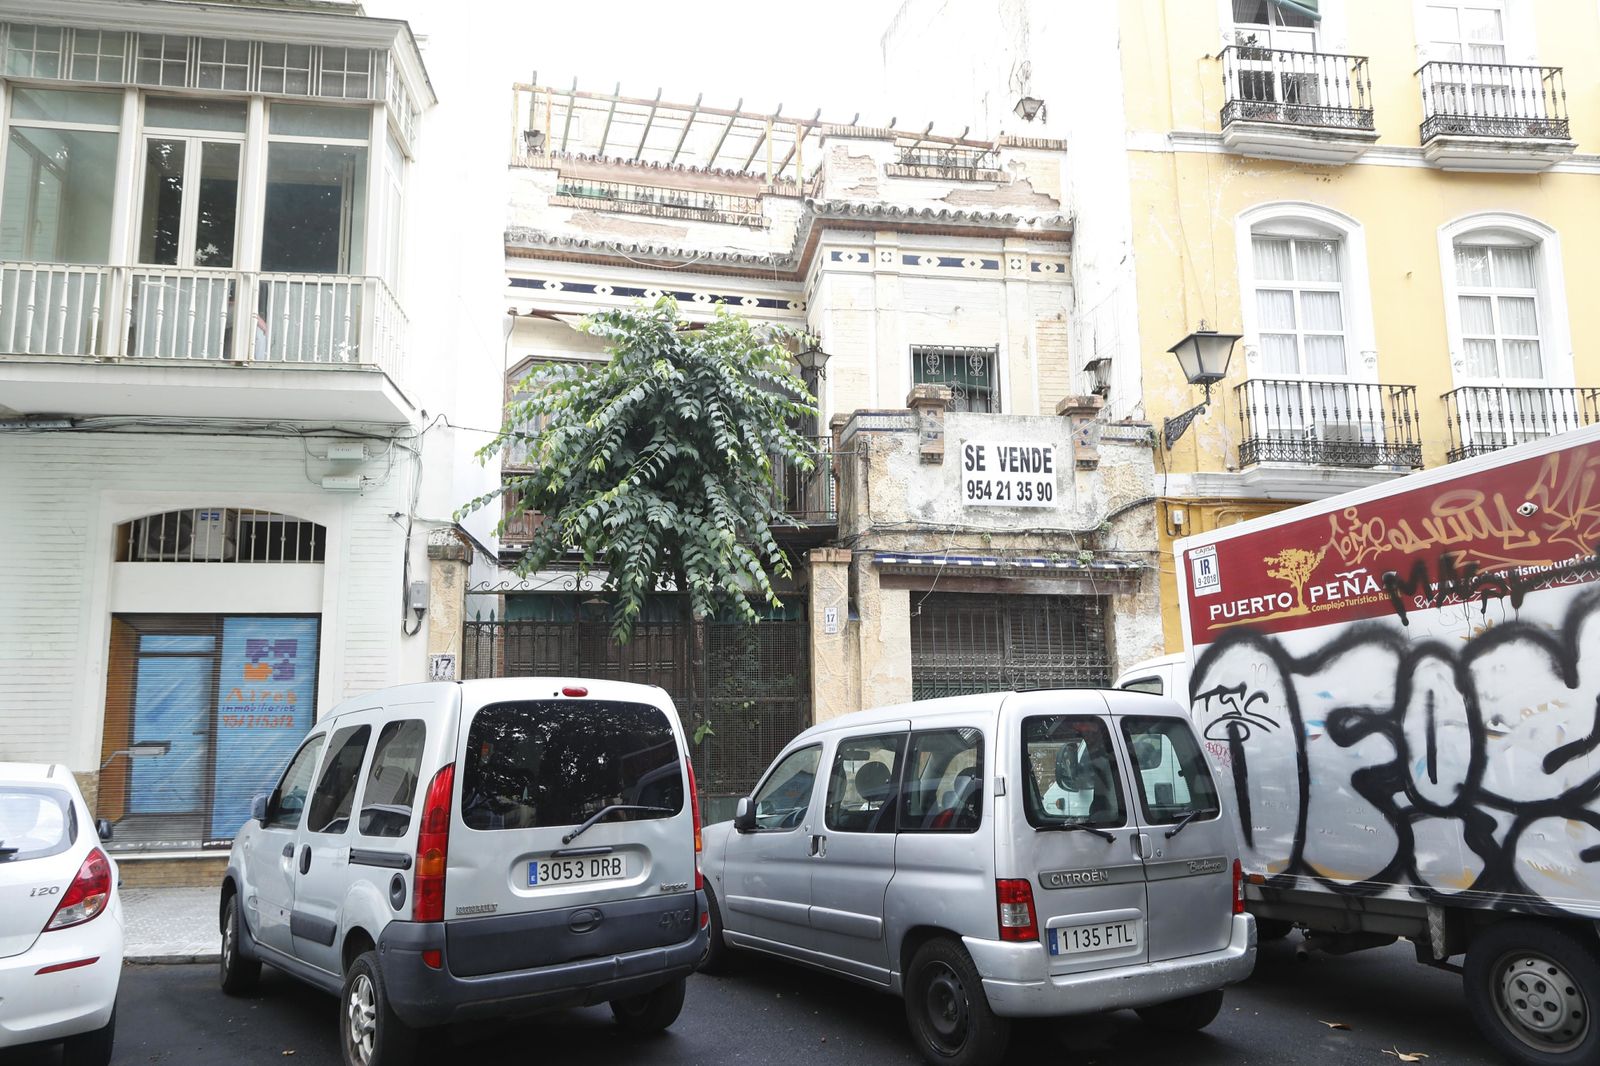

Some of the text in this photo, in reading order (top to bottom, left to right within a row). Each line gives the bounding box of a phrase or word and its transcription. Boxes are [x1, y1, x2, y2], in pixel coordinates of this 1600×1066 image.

[965, 444, 1053, 474] SE VENDE
[967, 479, 1053, 502] 954 21 35 90
[1200, 559, 1211, 575] IR
[1209, 592, 1293, 621] PUERTO
[1309, 567, 1397, 604] PEÑA
[1311, 601, 1345, 612] Complejo
[1345, 595, 1378, 606] Turístico
[826, 613, 836, 622] 17
[435, 658, 451, 676] 17
[540, 857, 622, 882] 3053 DRB
[1051, 869, 1109, 886] CITROËN
[29, 886, 60, 898] i20
[1062, 924, 1133, 950] 1135 FTL
